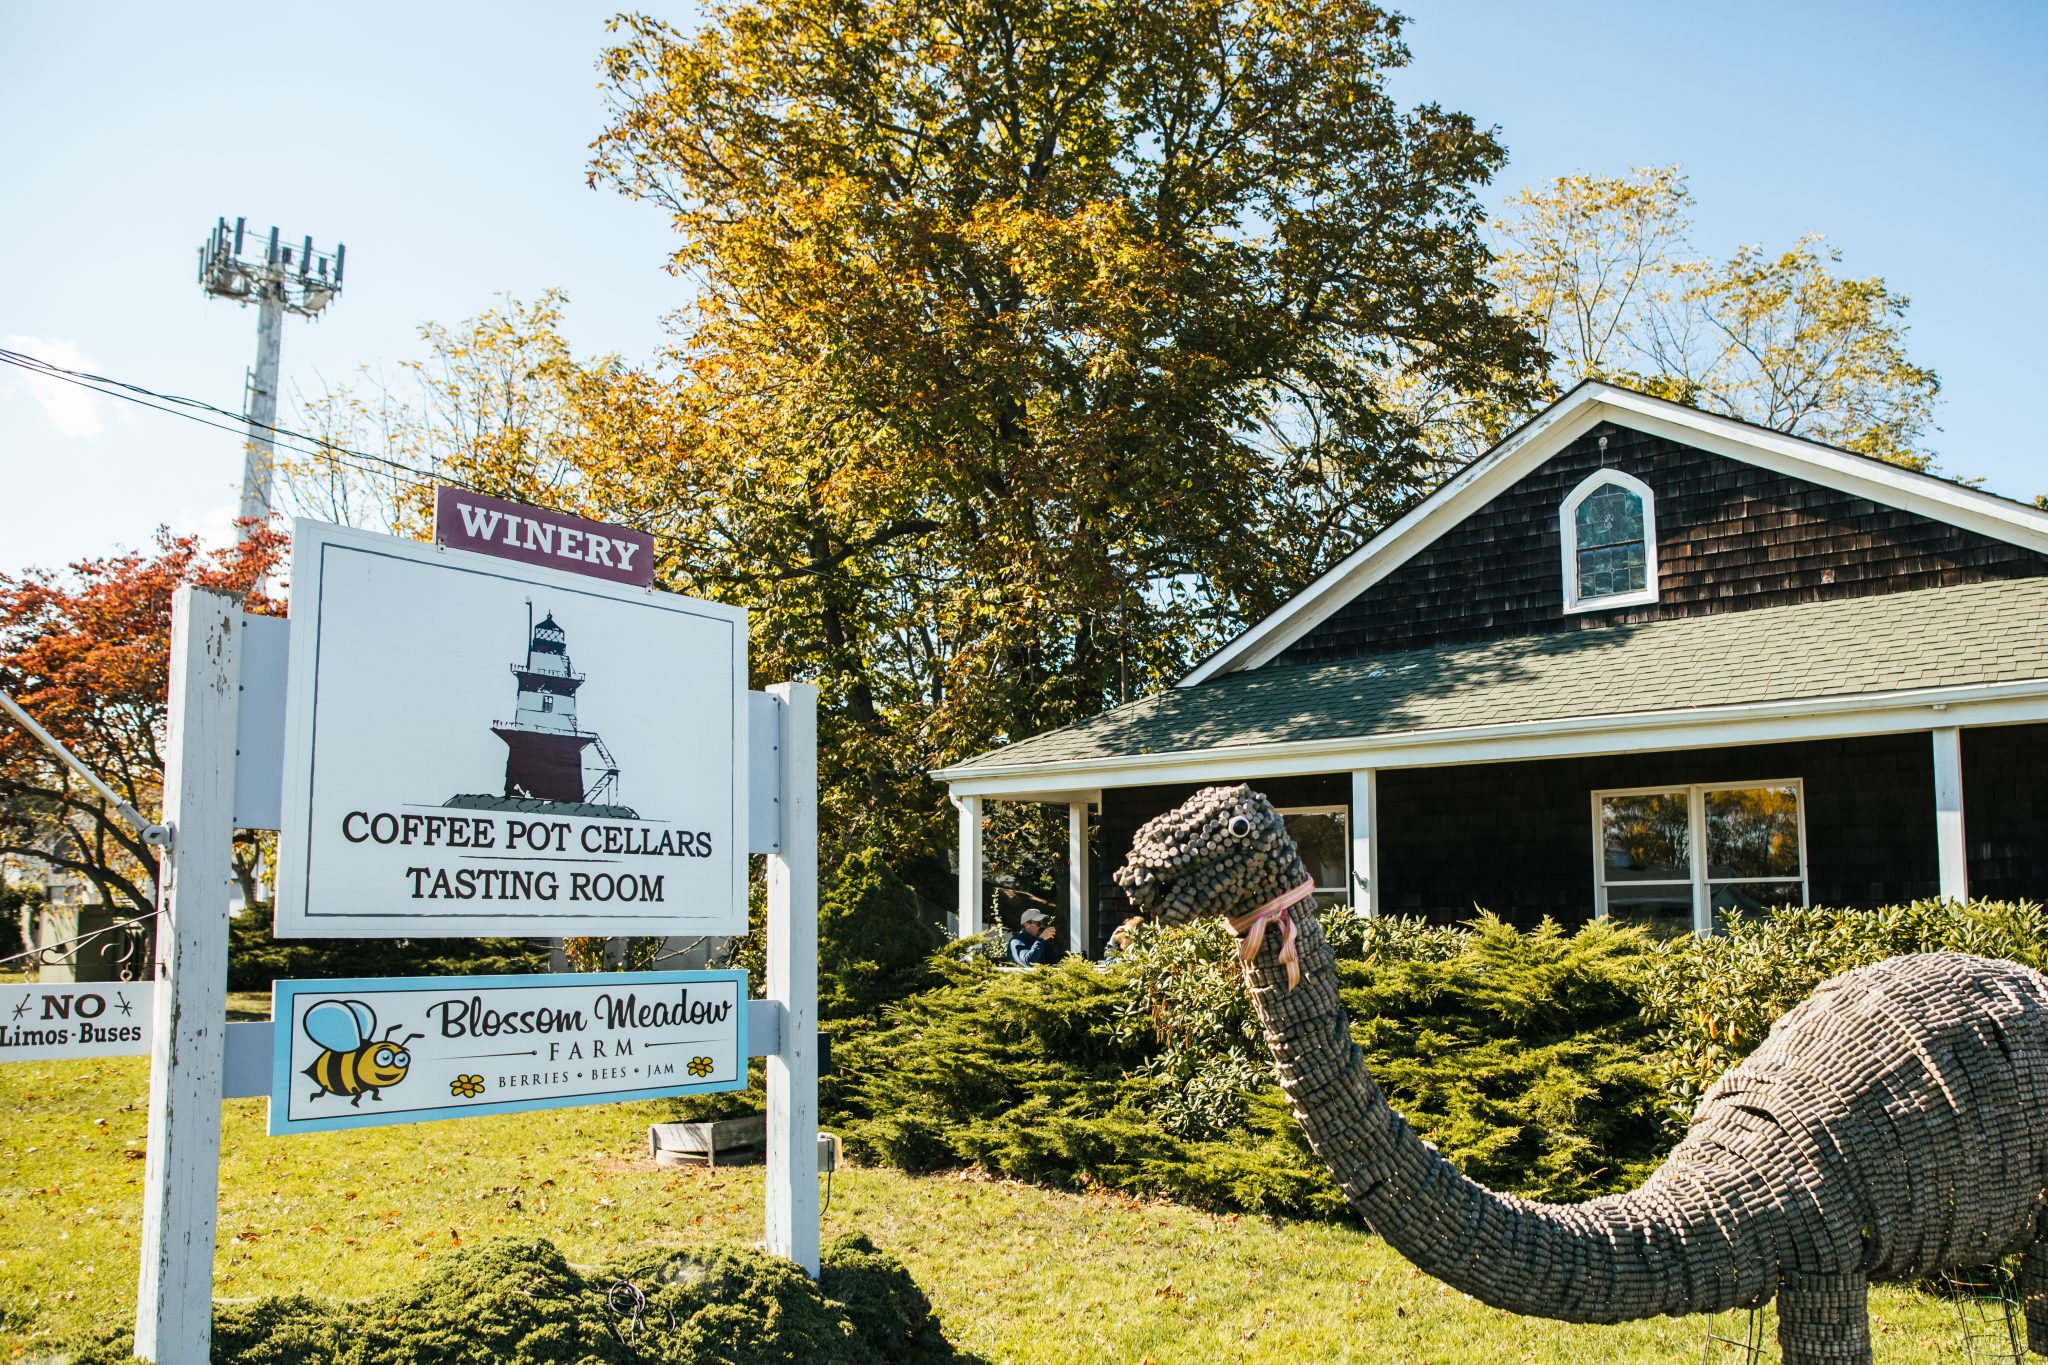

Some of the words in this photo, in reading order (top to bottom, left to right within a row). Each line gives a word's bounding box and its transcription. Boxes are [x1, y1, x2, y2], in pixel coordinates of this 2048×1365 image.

[456, 502, 640, 571] WINERY
[342, 810, 496, 849] COFFEE
[505, 820, 572, 852] POT
[580, 824, 713, 859] CELLARS
[405, 866, 560, 901] TASTING
[569, 872, 665, 903] ROOM
[40, 993, 107, 1021] NO
[426, 995, 588, 1039] Blossom
[594, 988, 733, 1030] Meadow
[548, 1038, 634, 1062] FARM
[498, 1071, 570, 1088] BERRIES
[591, 1066, 628, 1081] BEES
[646, 1063, 675, 1078] JAM
